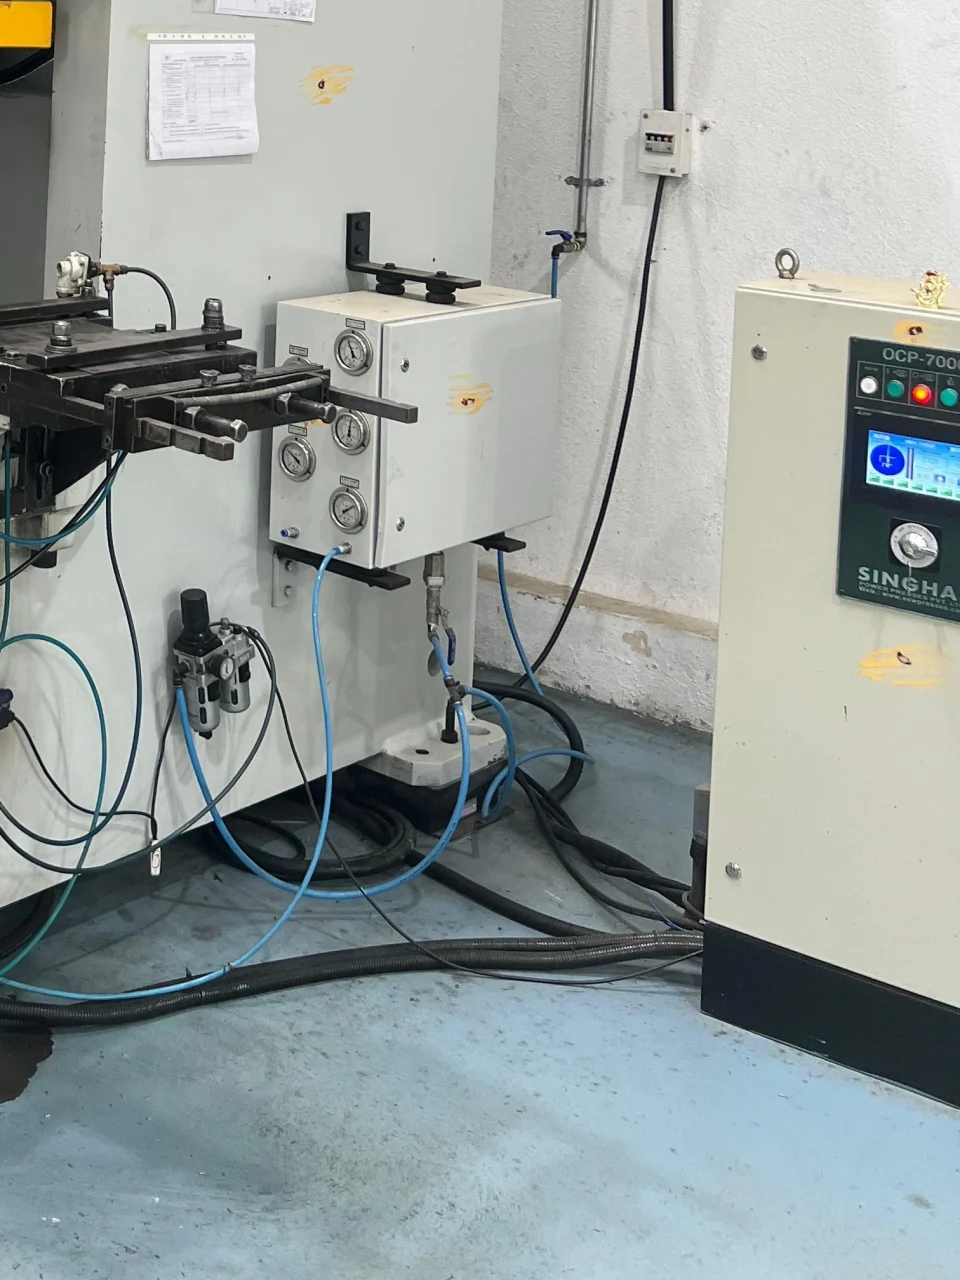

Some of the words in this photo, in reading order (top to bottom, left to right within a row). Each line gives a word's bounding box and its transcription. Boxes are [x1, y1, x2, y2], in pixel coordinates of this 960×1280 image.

[882, 347, 960, 370] OCP-700
[859, 581, 889, 592] POWER
[890, 588, 929, 601] PRESSES
